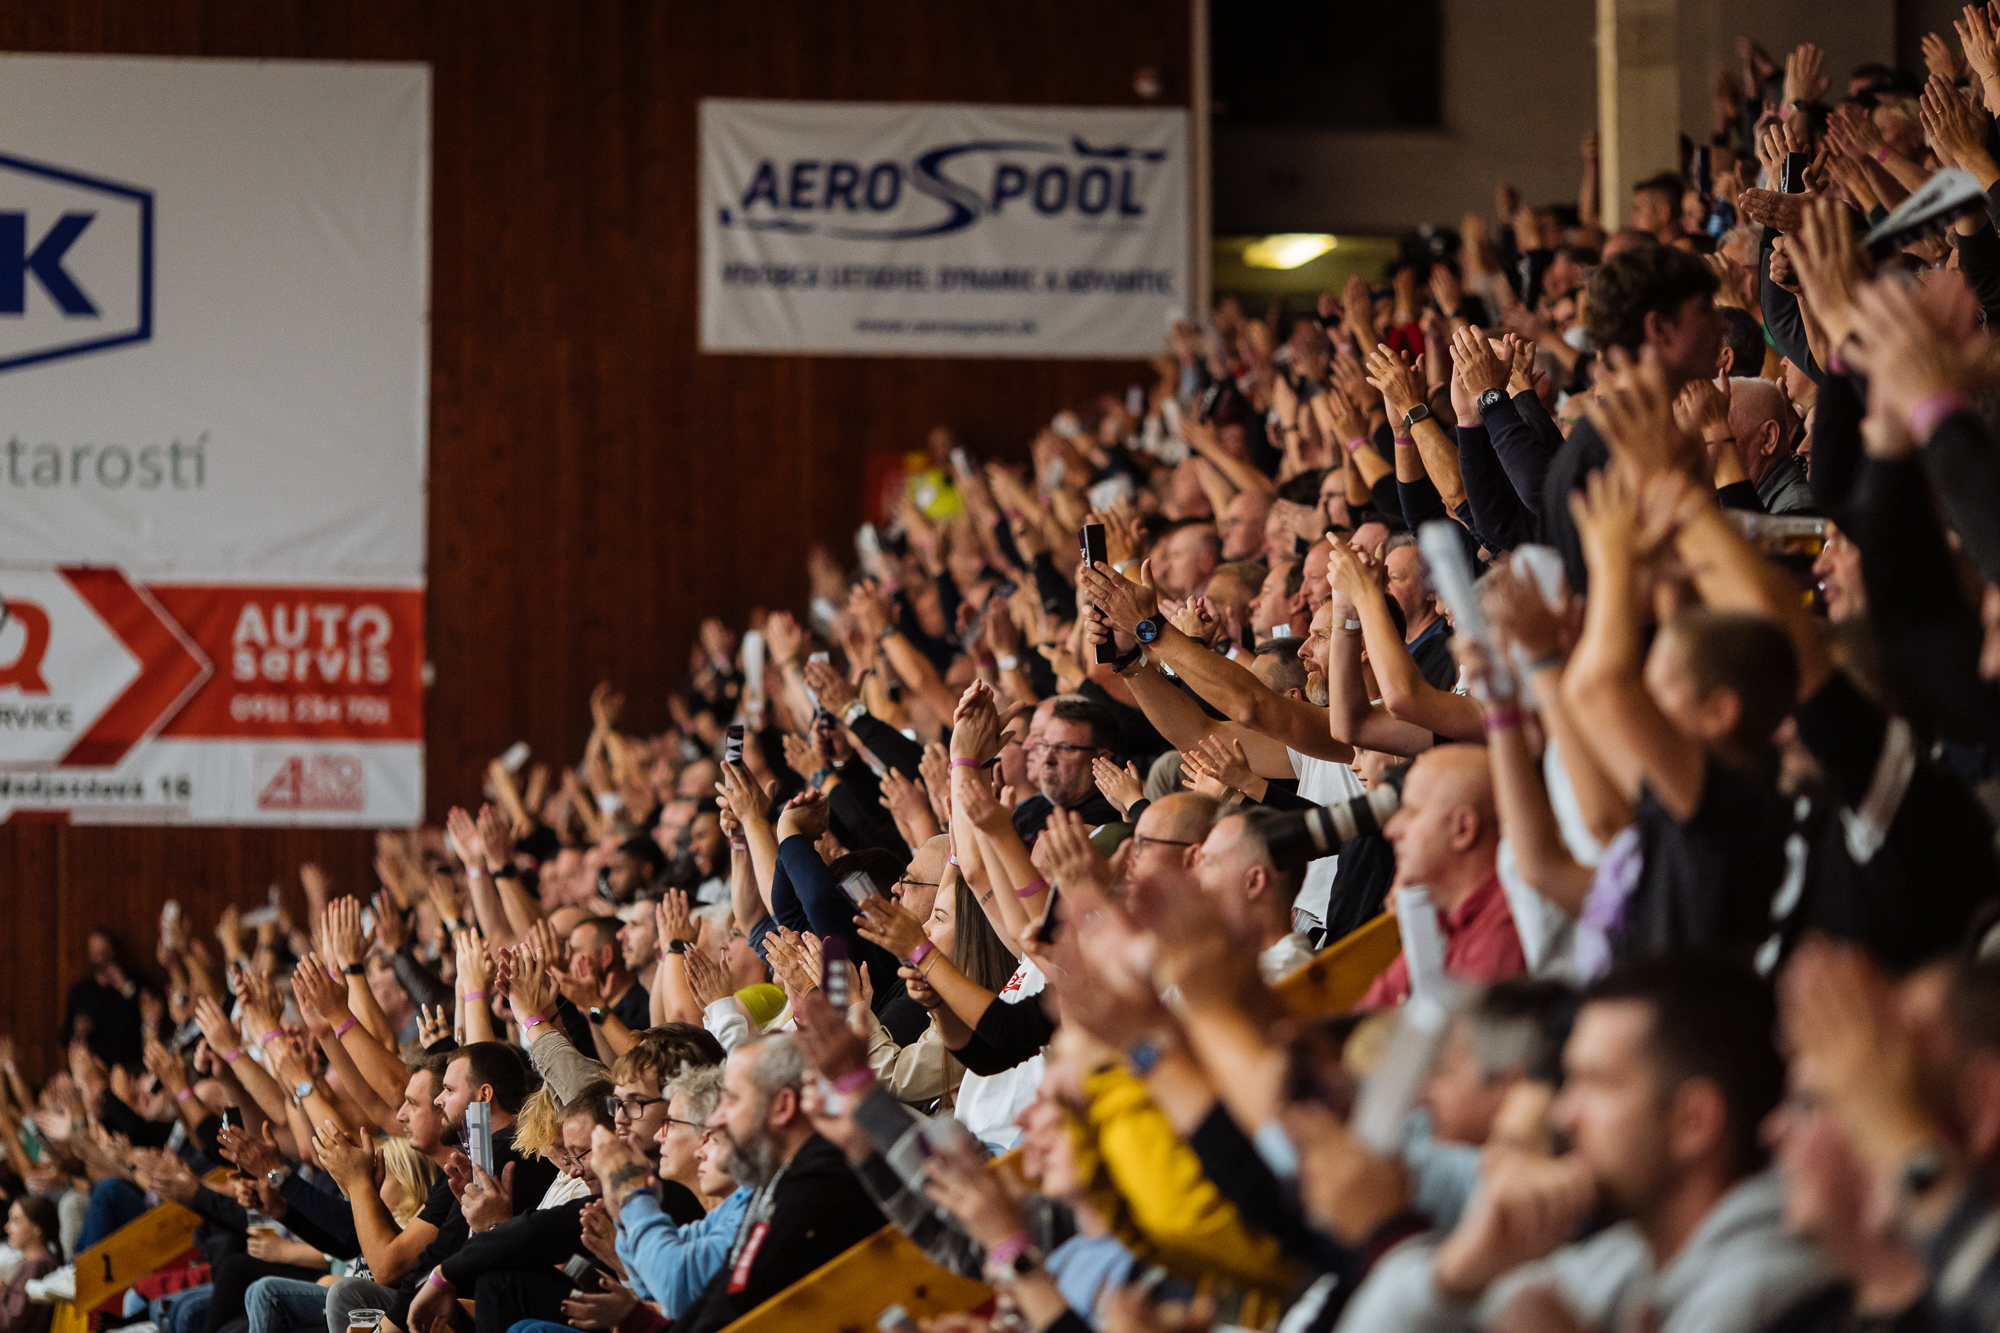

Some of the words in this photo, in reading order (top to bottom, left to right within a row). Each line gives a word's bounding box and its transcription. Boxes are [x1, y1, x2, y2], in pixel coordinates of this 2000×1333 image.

[742, 142, 1146, 236] AEROSPOOL
[0, 430, 207, 489] tarostí
[232, 602, 392, 648] AUTO
[102, 1253, 114, 1283] 1
